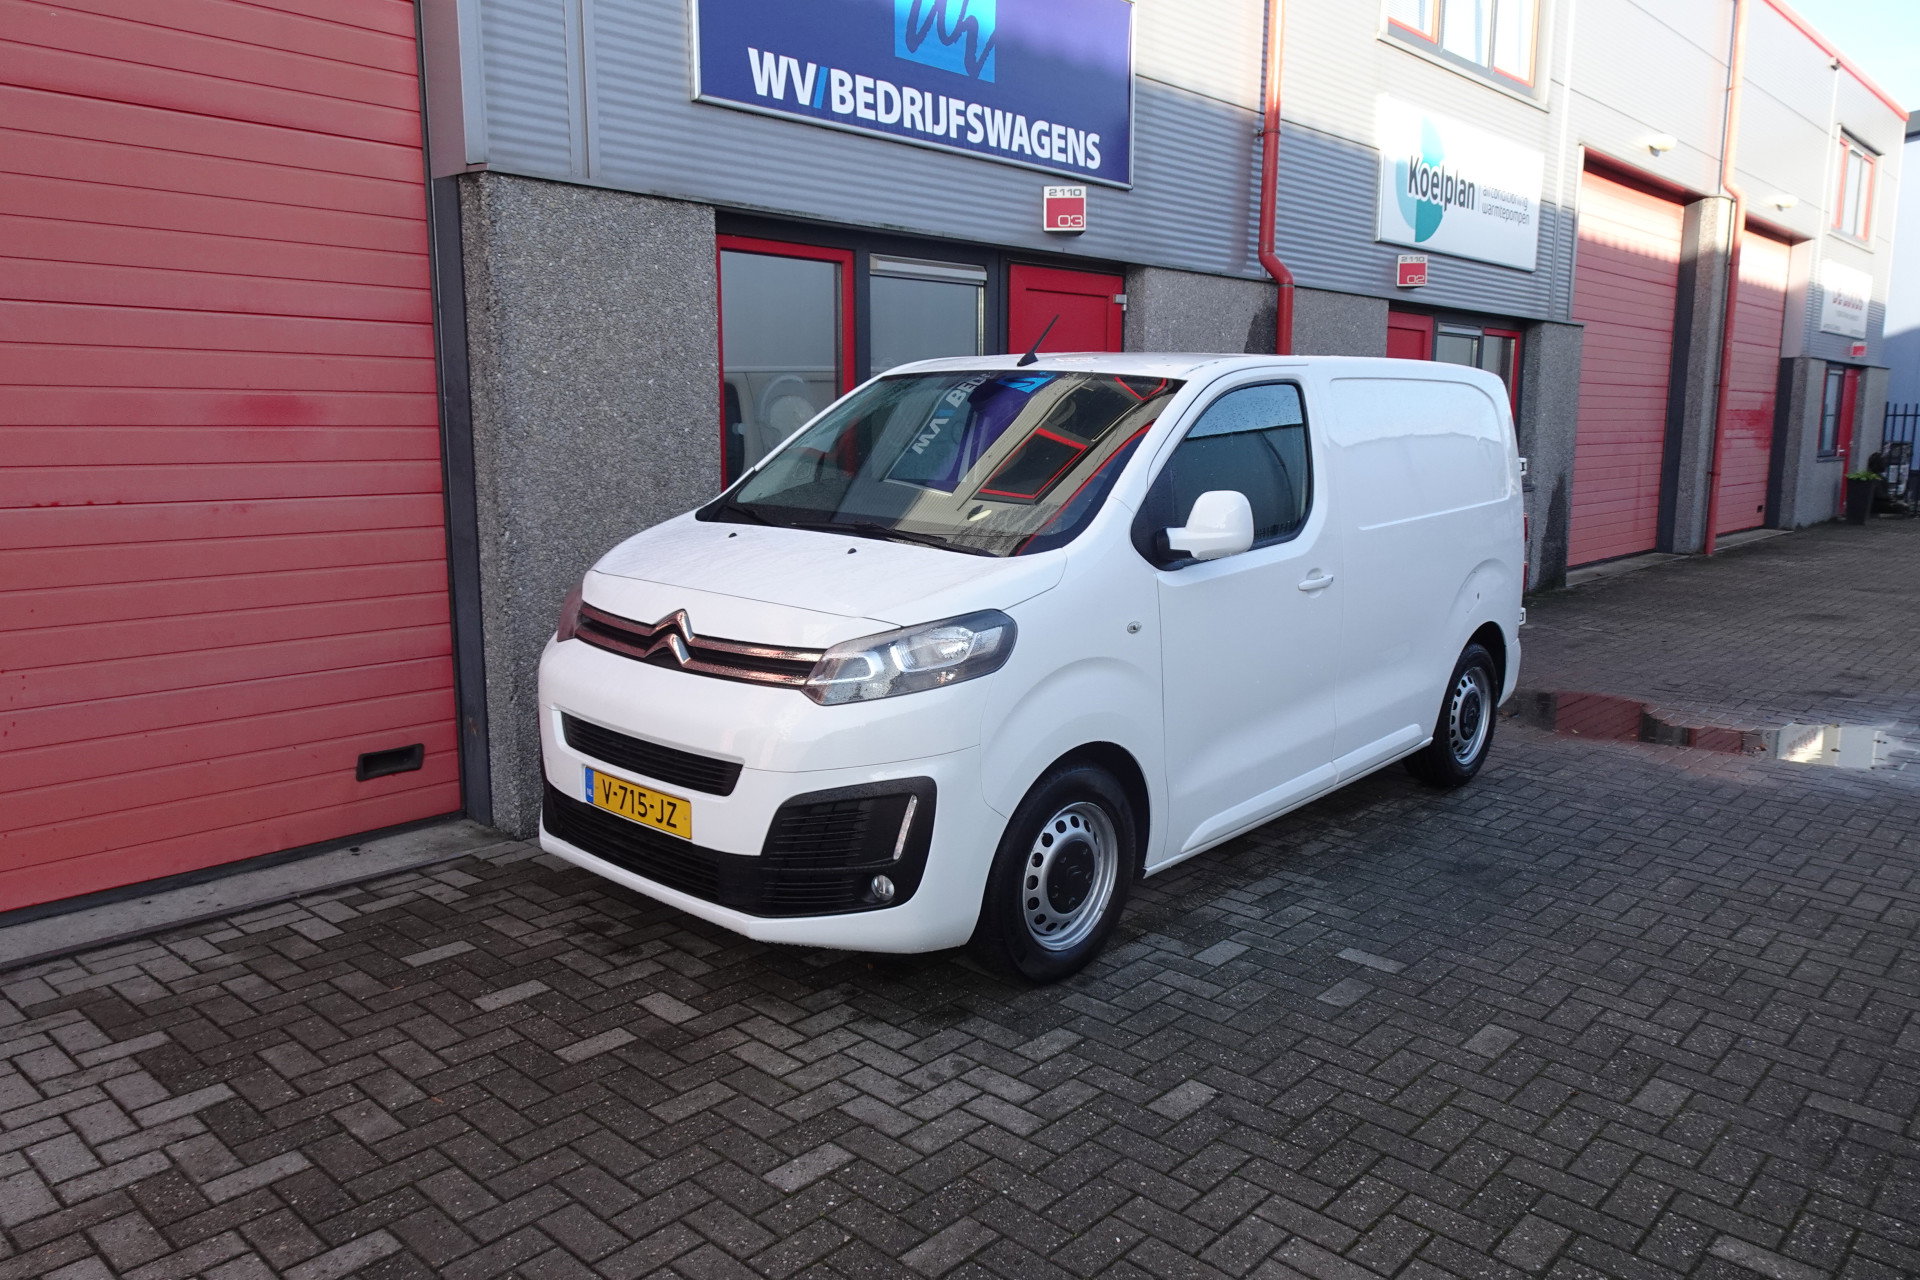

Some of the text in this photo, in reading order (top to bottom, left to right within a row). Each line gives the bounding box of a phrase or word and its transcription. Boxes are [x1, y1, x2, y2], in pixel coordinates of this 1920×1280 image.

[1408, 155, 1475, 212] Koelplan
[1048, 188, 1082, 197] 2110
[1057, 214, 1084, 227] 03
[1406, 274, 1425, 284] 02
[602, 778, 678, 829] V-715-JZ
